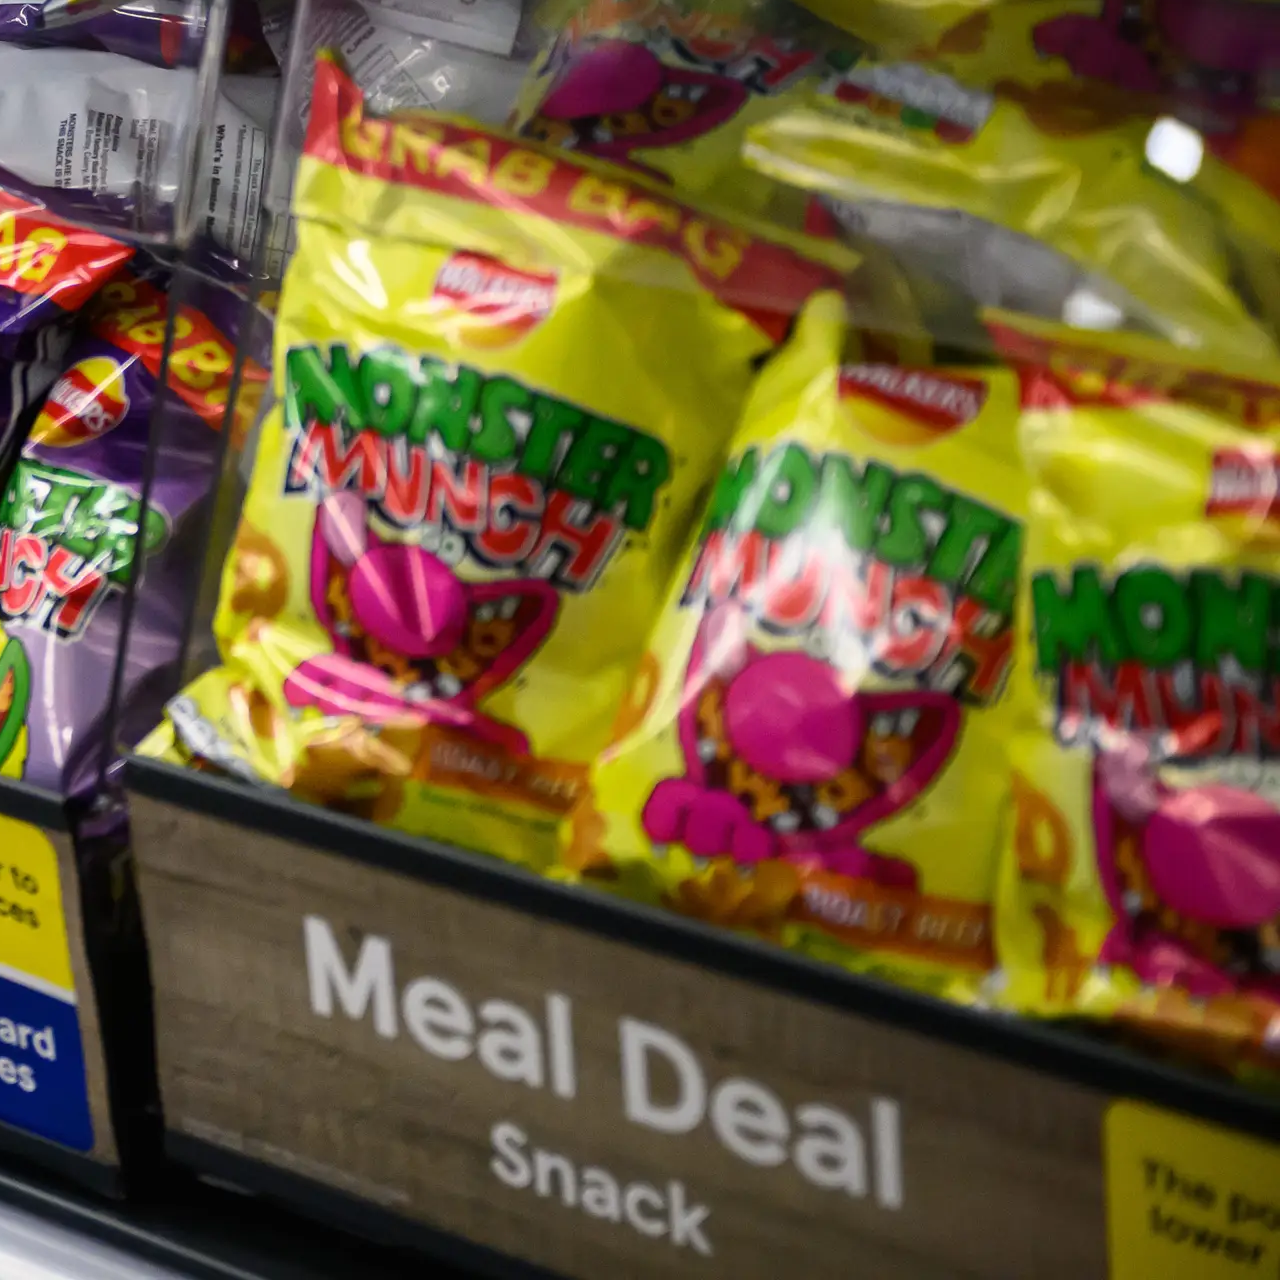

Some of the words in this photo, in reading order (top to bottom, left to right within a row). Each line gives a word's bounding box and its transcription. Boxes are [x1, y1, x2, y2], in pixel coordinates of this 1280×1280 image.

[342, 120, 556, 195] GRAB
[284, 340, 672, 531] MONSTER
[284, 420, 625, 594] MUNCH
[682, 529, 1017, 708] MUNCH
[7, 862, 39, 898] to
[805, 883, 904, 931] ROAST
[303, 915, 575, 1098] Meal
[621, 1017, 905, 1209] Deal
[490, 1121, 714, 1258] Snack
[1143, 1157, 1218, 1211] The
